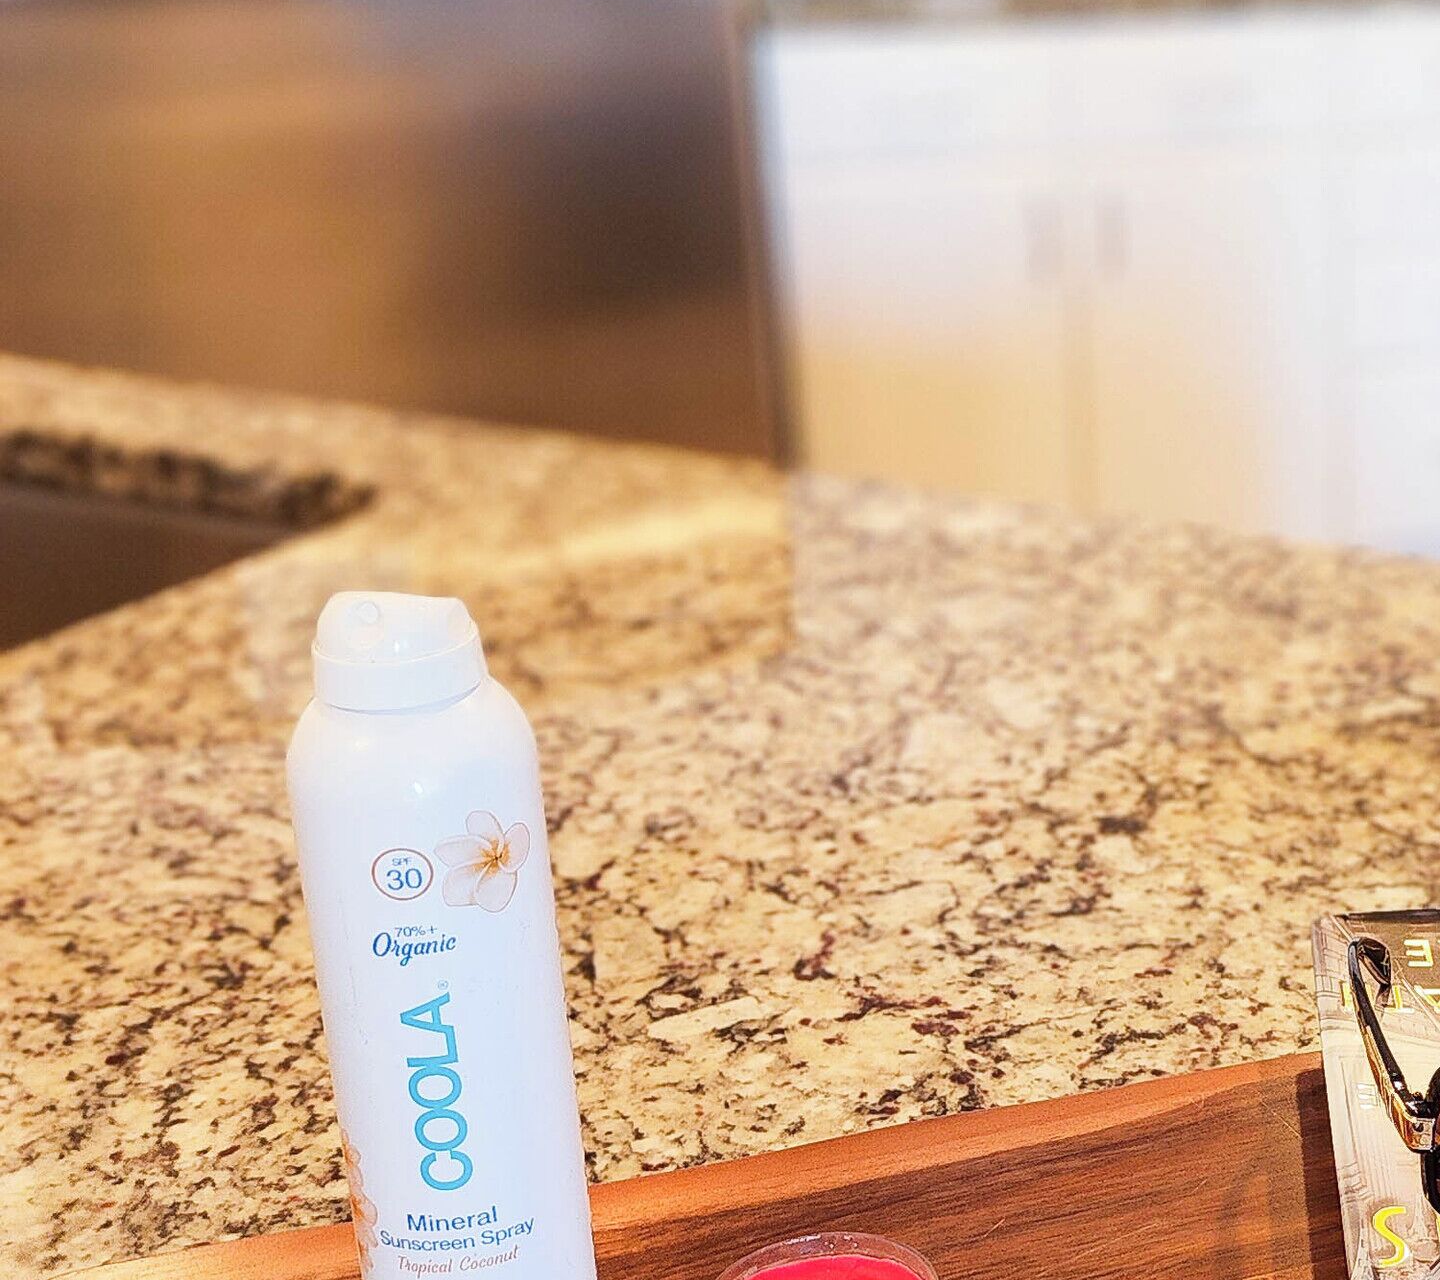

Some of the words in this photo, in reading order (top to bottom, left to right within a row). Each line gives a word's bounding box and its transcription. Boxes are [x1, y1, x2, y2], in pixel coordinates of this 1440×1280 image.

[386, 868, 423, 891] 30
[392, 857, 412, 867] SPF
[373, 931, 457, 967] Organic
[400, 991, 474, 1191] COOLA
[380, 1230, 476, 1252] Sunscreen
[481, 1217, 535, 1245] Spray
[406, 1206, 499, 1232] Mineral
[398, 1255, 453, 1279] Tropical
[459, 1244, 521, 1271] Coconut
